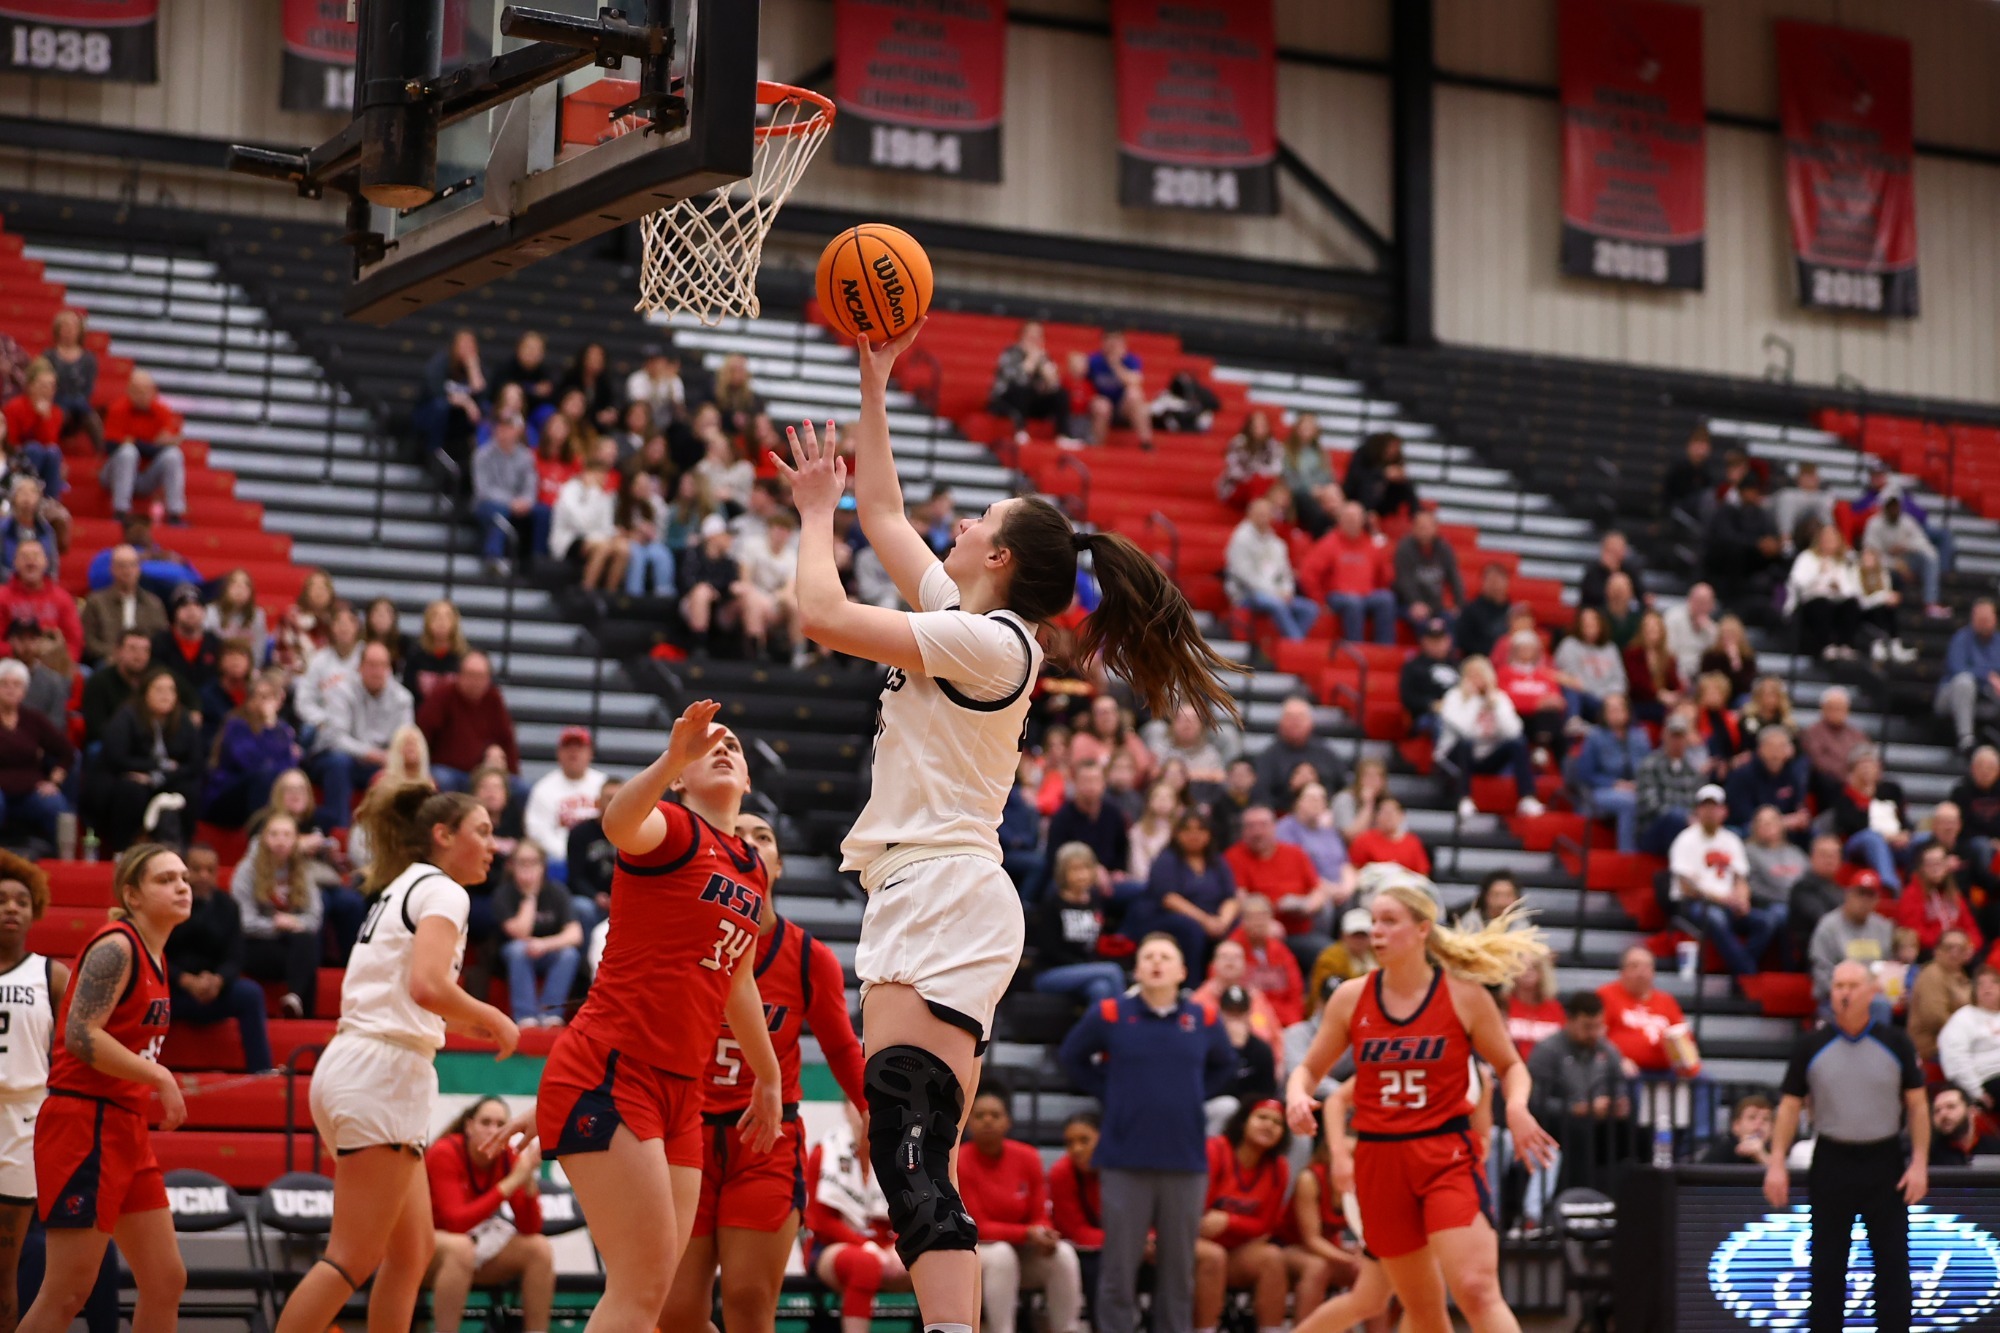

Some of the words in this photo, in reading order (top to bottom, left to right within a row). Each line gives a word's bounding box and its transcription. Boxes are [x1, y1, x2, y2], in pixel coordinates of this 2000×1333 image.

[12, 25, 112, 74] 1938
[871, 125, 961, 173] 1984
[1152, 166, 1239, 210] 2014
[1592, 239, 1669, 285] 2015
[841, 279, 874, 333] NCAA
[872, 252, 907, 329] Wilson
[1812, 268, 1883, 311] 2015
[699, 918, 754, 977] 34
[0, 984, 35, 1006] IES
[713, 1037, 741, 1086] 5
[1359, 1035, 1447, 1063] RSU
[1379, 1069, 1427, 1109] 25
